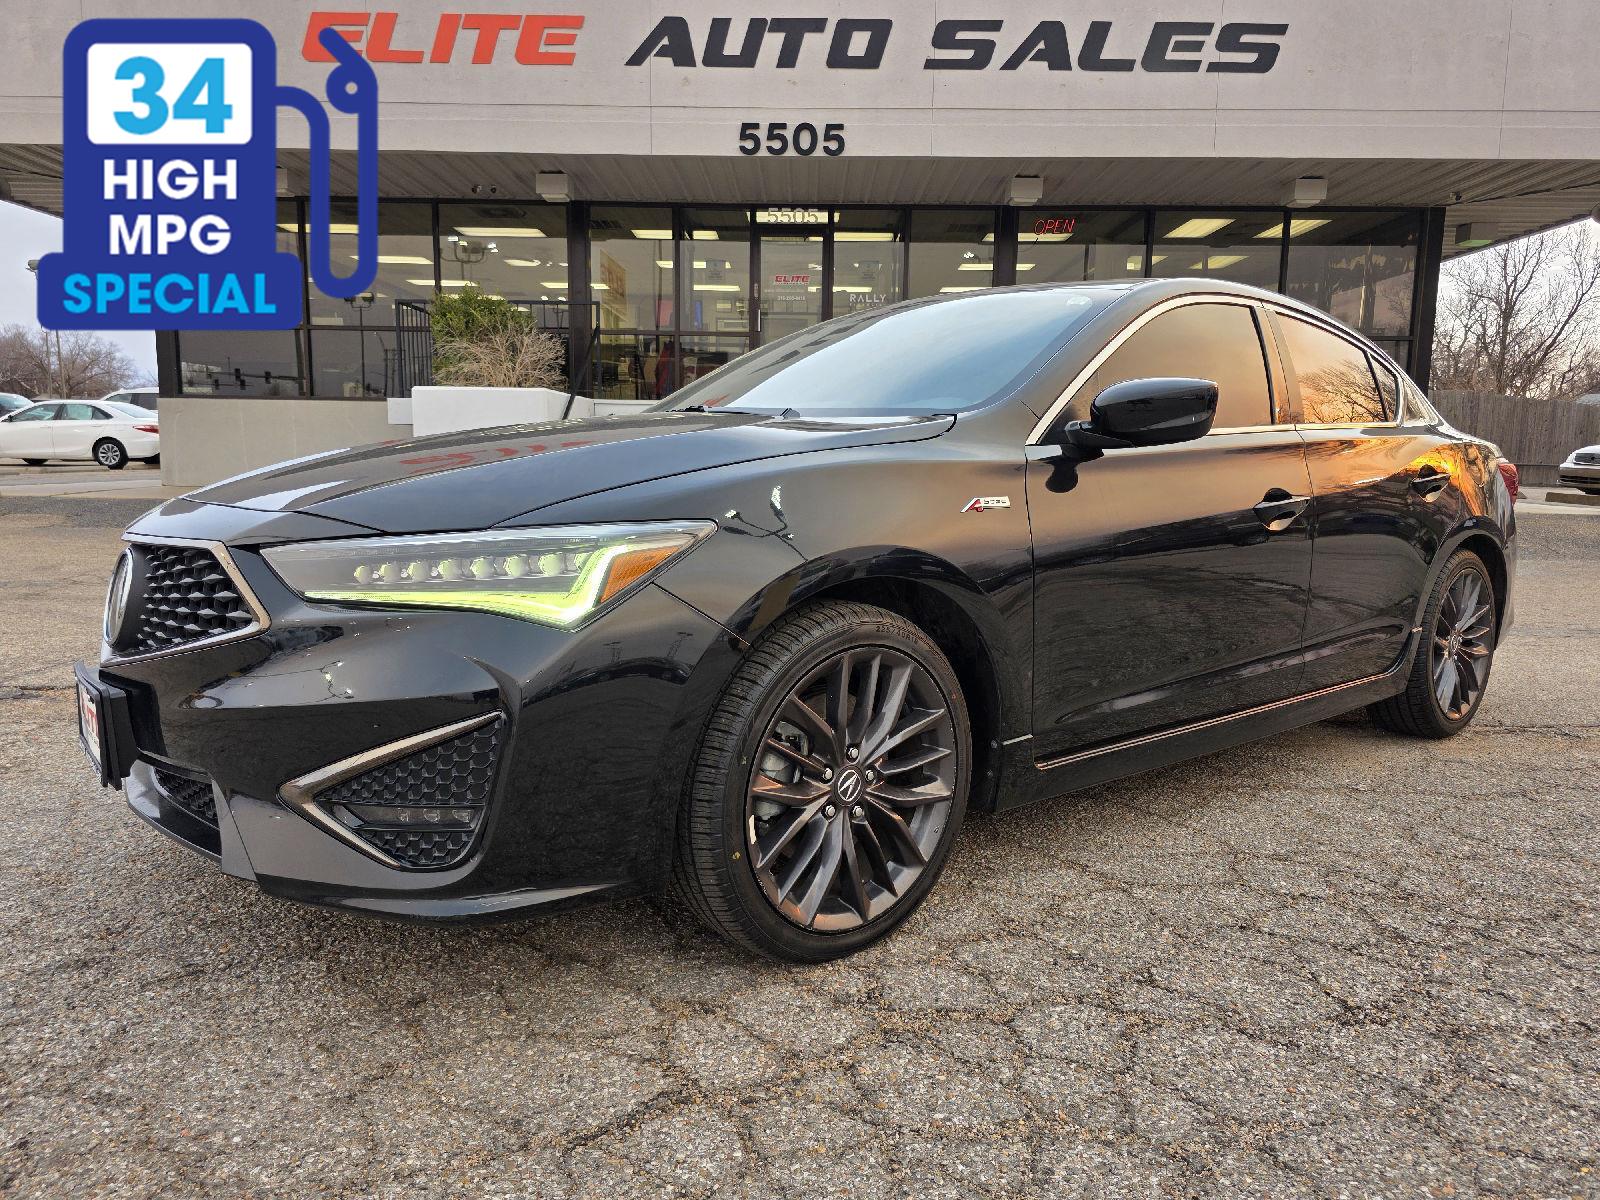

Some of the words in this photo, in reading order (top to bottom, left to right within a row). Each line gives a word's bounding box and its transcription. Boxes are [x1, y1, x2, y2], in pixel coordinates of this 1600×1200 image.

[302, 12, 585, 65] ELITE
[625, 16, 893, 70] AUTO
[924, 19, 1290, 73] SALES
[739, 122, 845, 157] 5505
[767, 207, 819, 225] 5505
[1034, 219, 1075, 235] OPEN
[775, 275, 810, 283] ELITE
[850, 293, 886, 303] RALLY
